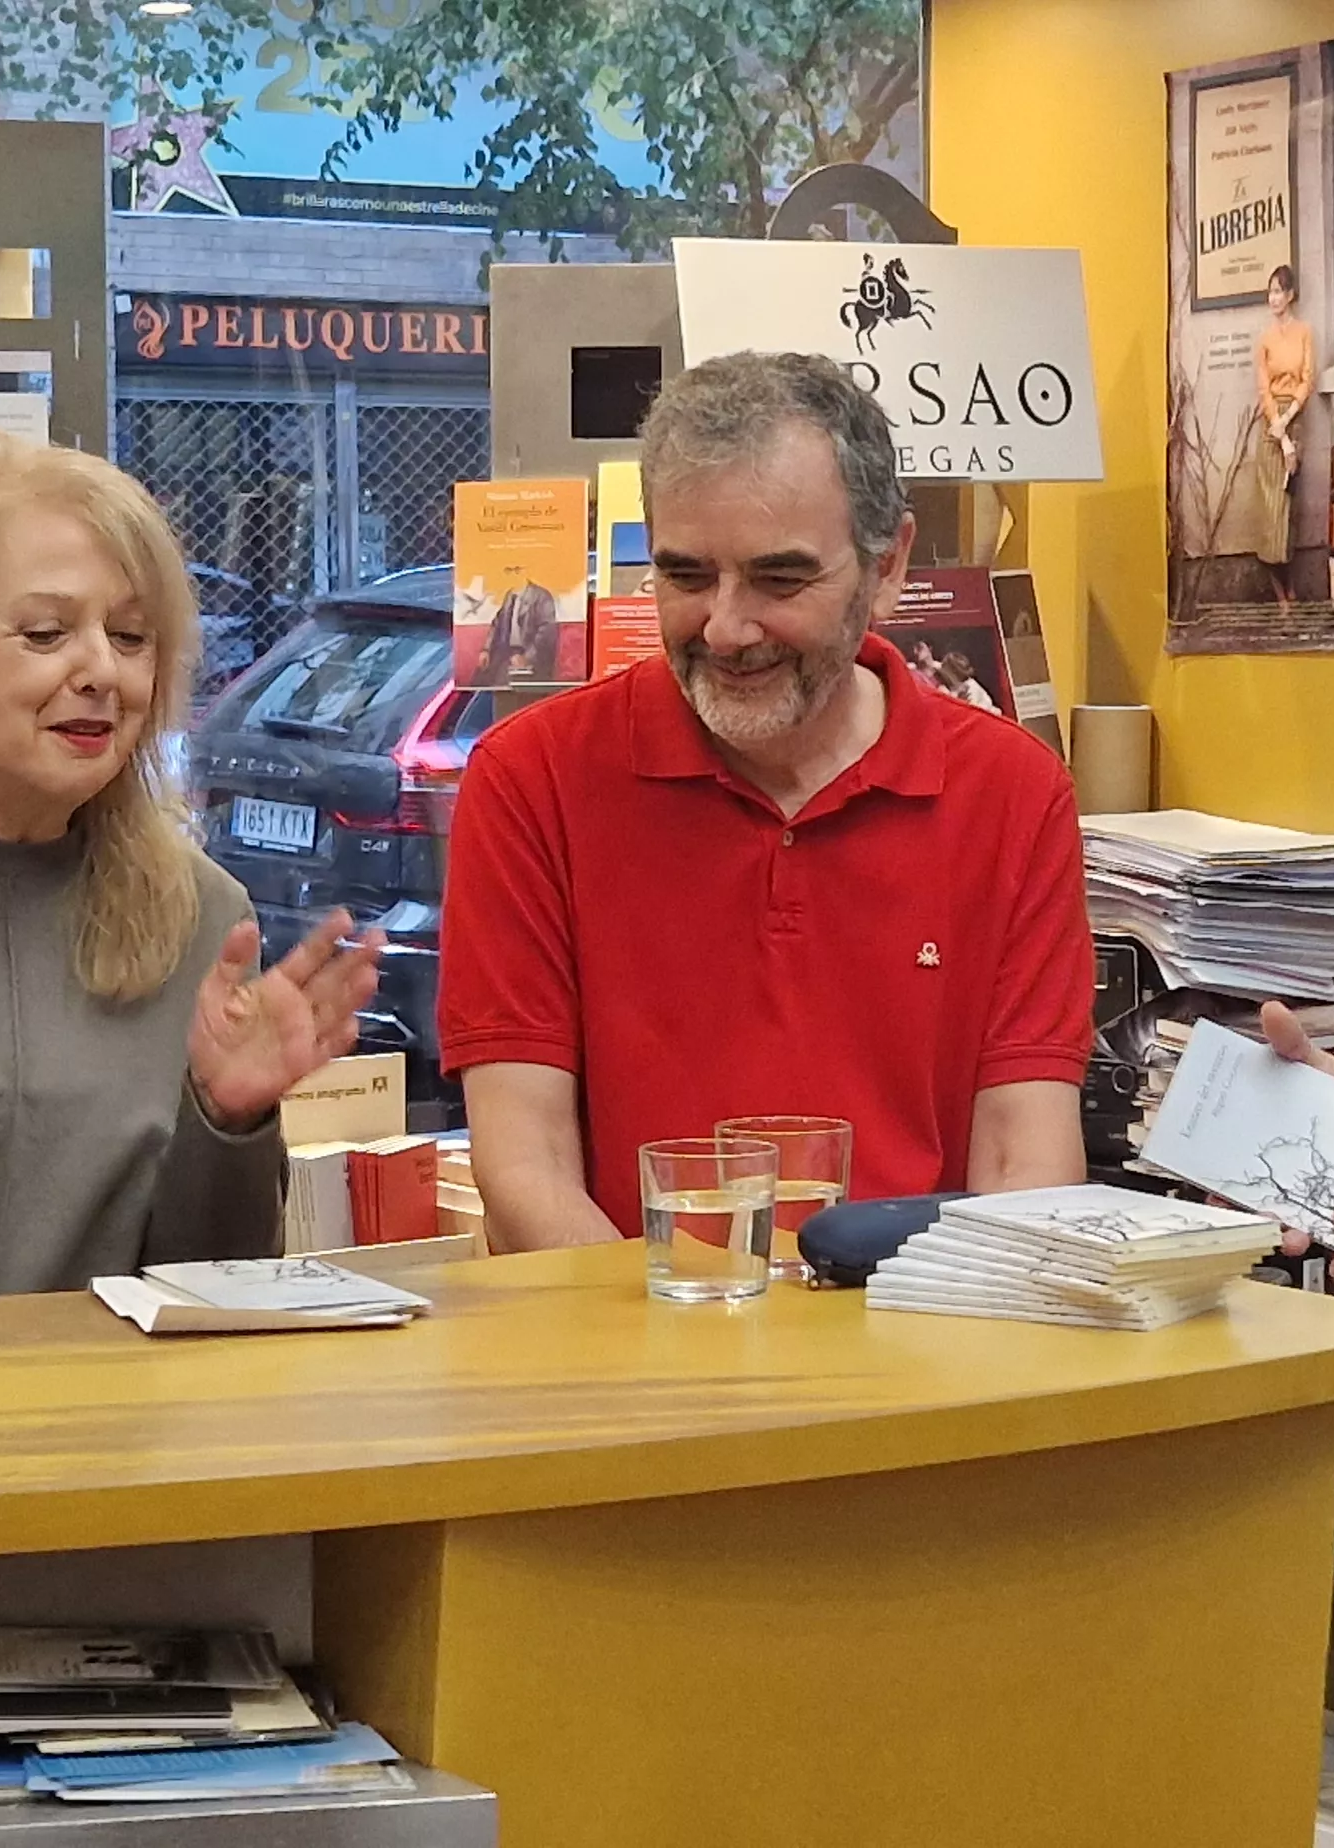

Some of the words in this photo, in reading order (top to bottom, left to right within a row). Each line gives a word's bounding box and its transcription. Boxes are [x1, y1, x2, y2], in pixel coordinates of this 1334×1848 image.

[1200, 187, 1286, 255] LIBRERÍA
[179, 304, 488, 361] PELUQUERI
[840, 361, 1073, 428] RSAO
[897, 445, 1016, 473] EGAS
[279, 809, 310, 839] KTX
